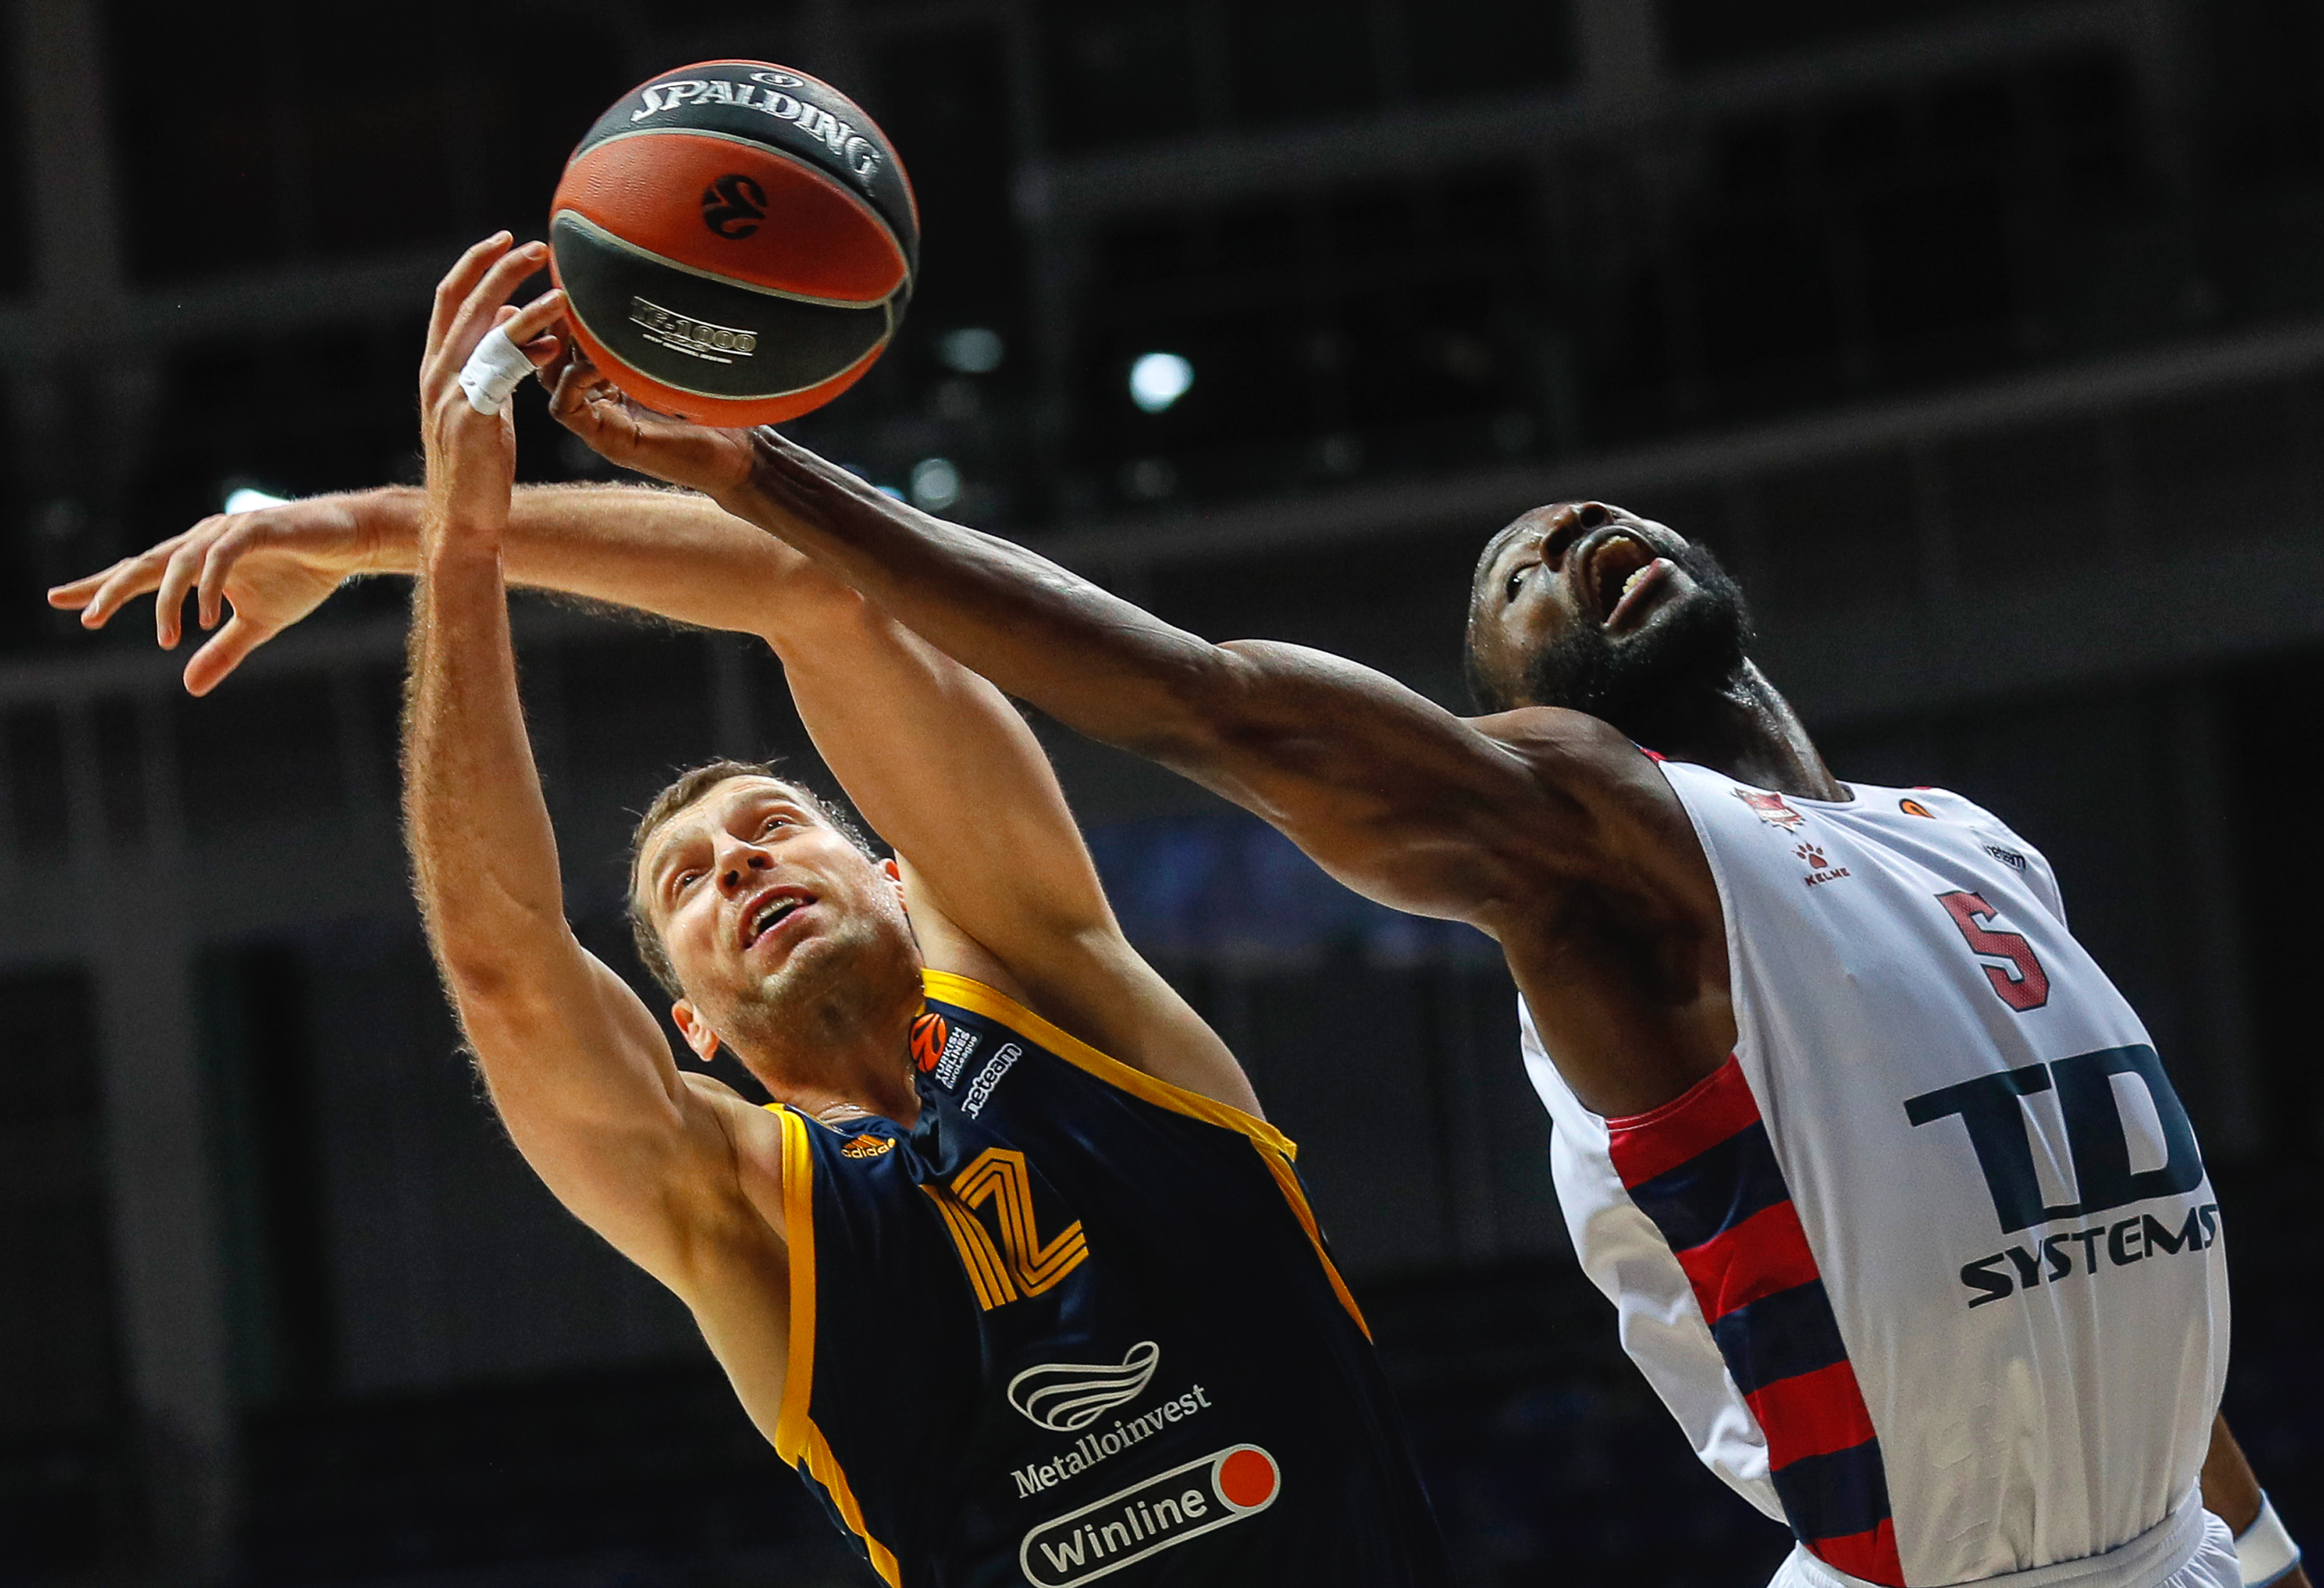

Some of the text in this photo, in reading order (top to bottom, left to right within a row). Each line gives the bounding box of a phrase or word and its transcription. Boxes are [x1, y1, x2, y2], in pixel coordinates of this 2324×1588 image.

[630, 79, 882, 176] SPALDING
[1804, 868, 1851, 886] KELME
[1934, 890, 2050, 1012] 5
[935, 1026, 964, 1081] TURKISH
[941, 1031, 971, 1086] AIRLINES
[841, 1137, 897, 1159] adidas
[1903, 1043, 2204, 1235] TD
[918, 1146, 1090, 1311] 12
[1959, 1203, 2219, 1309] SYSTEMS
[1010, 1383, 1212, 1499] Metalloinvest
[1039, 1488, 1208, 1573] Winline
